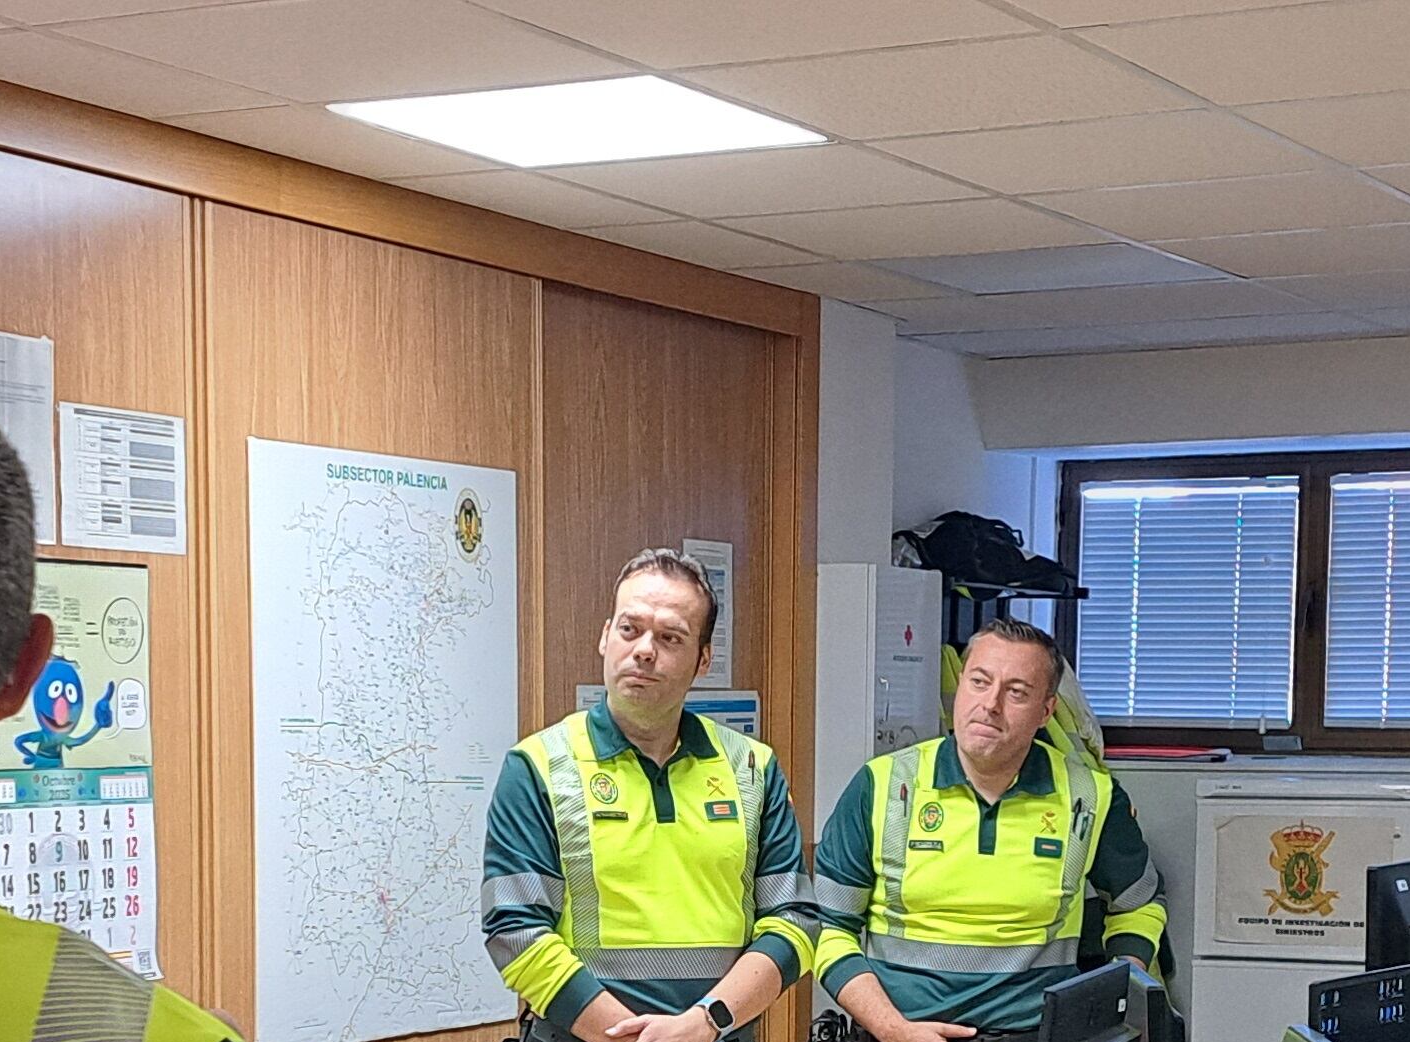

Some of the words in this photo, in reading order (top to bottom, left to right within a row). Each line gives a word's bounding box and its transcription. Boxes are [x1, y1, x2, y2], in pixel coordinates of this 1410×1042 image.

[327, 463, 394, 485] SUBSECTOR
[397, 472, 448, 490] PALENCIA
[42, 774, 76, 787] Octubre
[29, 812, 34, 833] 1
[55, 810, 62, 832] 2
[79, 810, 85, 831] 3
[104, 808, 110, 830] 4
[128, 807, 134, 828] 5
[3, 844, 10, 865] 7
[29, 842, 37, 864] 8
[55, 841, 63, 862] 9
[77, 839, 89, 861] 10
[102, 838, 112, 859] 11
[126, 837, 138, 857] 12
[1, 875, 14, 897] 14
[28, 873, 39, 895] 15
[54, 871, 66, 893] 16
[79, 869, 89, 891] 17
[102, 868, 114, 889] 18
[126, 866, 138, 887] 19
[28, 904, 42, 922] 22
[54, 901, 67, 923] 23
[79, 900, 92, 921] 24
[102, 897, 116, 919] 25
[125, 895, 139, 916] 26
[1271, 918, 1282, 926] DE
[108, 927, 112, 948] 1
[131, 926, 136, 945] 2
